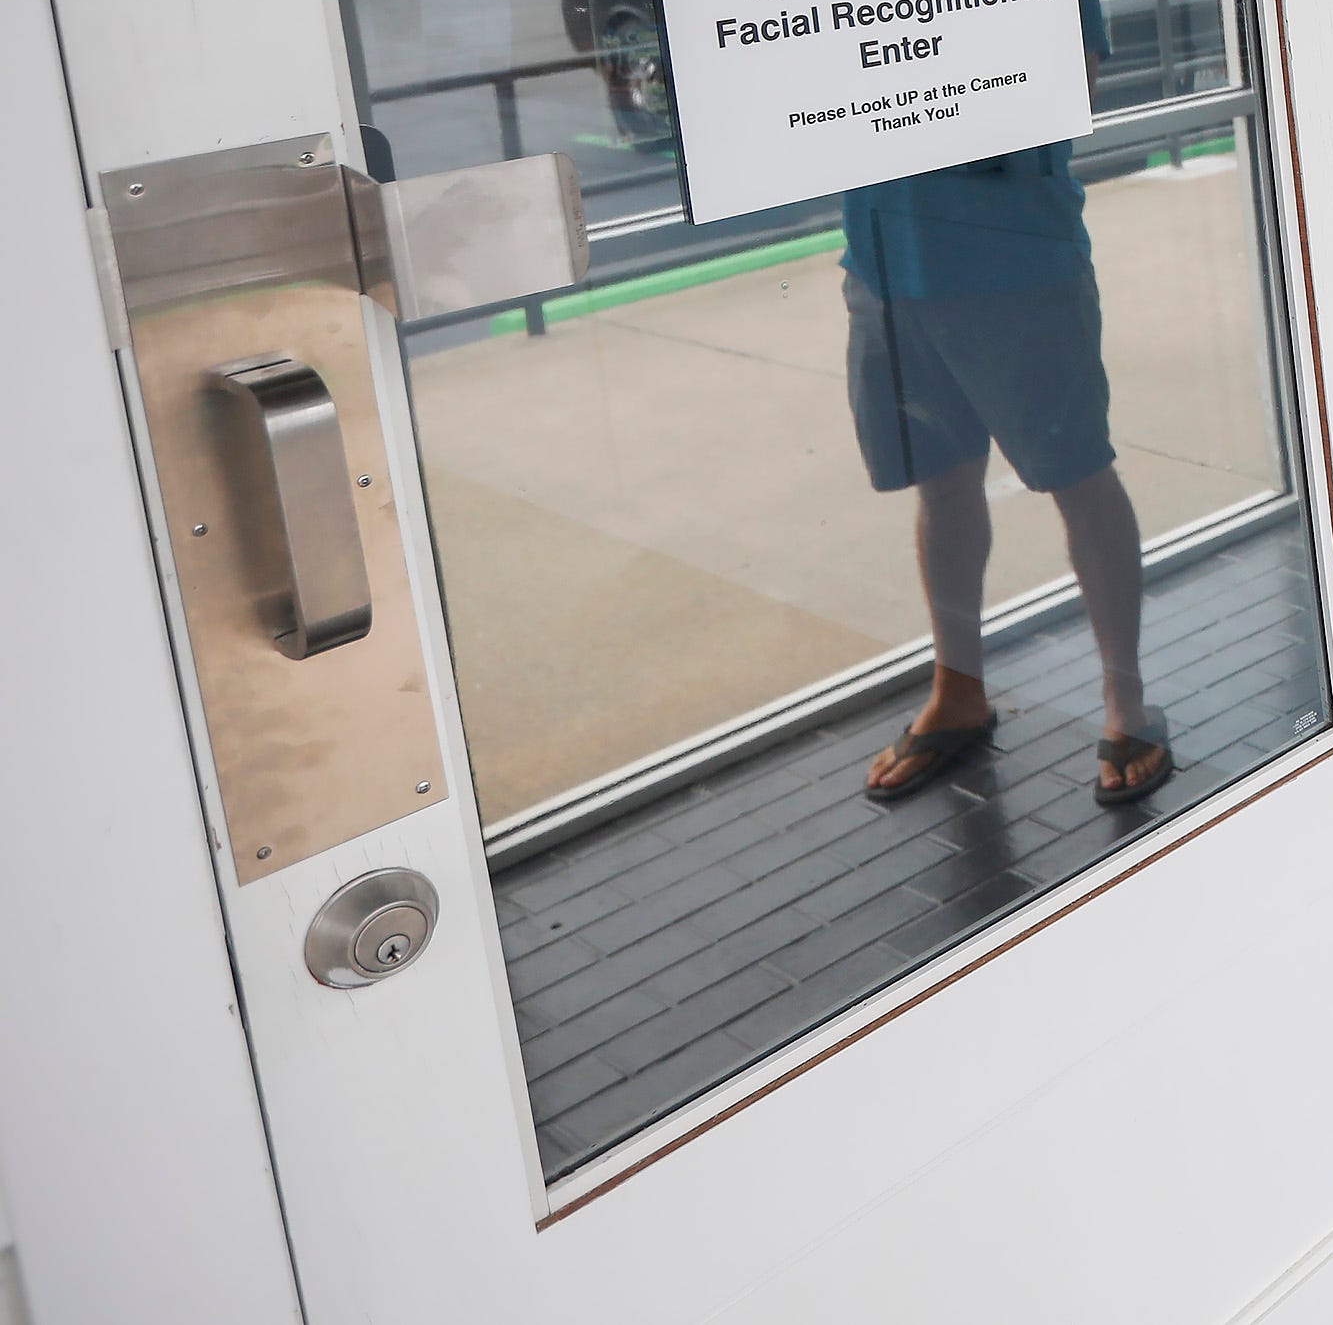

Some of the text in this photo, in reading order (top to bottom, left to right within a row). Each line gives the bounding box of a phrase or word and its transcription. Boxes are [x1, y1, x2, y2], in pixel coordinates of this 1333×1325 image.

[715, 9, 821, 49] Facial
[859, 35, 943, 69] Enter
[788, 71, 1028, 128] Please Look UP at the Camera
[869, 102, 960, 133] Thank You!
